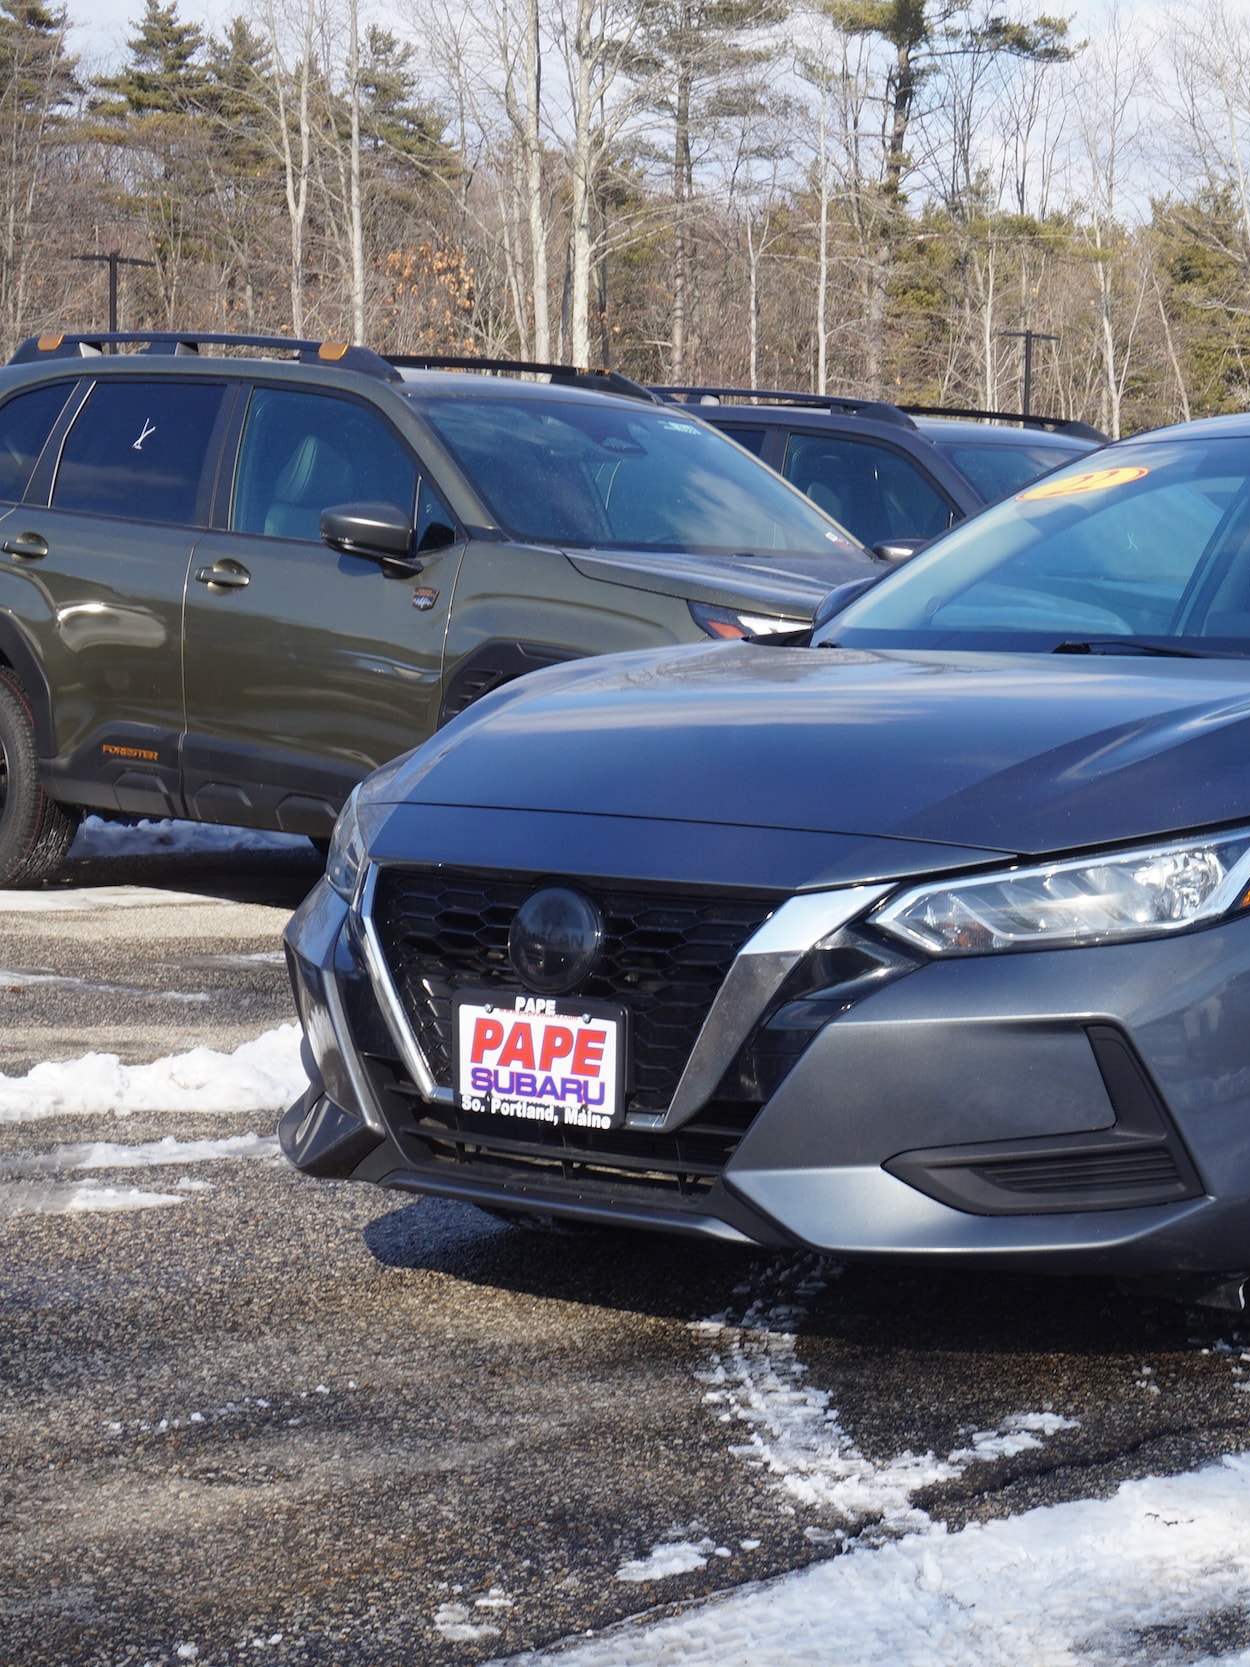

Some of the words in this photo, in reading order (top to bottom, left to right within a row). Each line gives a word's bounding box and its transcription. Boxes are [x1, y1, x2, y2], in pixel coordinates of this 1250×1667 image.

[102, 744, 159, 760] FORESTER
[514, 996, 557, 1015] PAPE
[470, 1017, 607, 1077] PAPE
[471, 1067, 605, 1106] SUBARU
[461, 1094, 486, 1113] So.
[491, 1097, 559, 1126] Portland,
[564, 1107, 611, 1130] Maine
